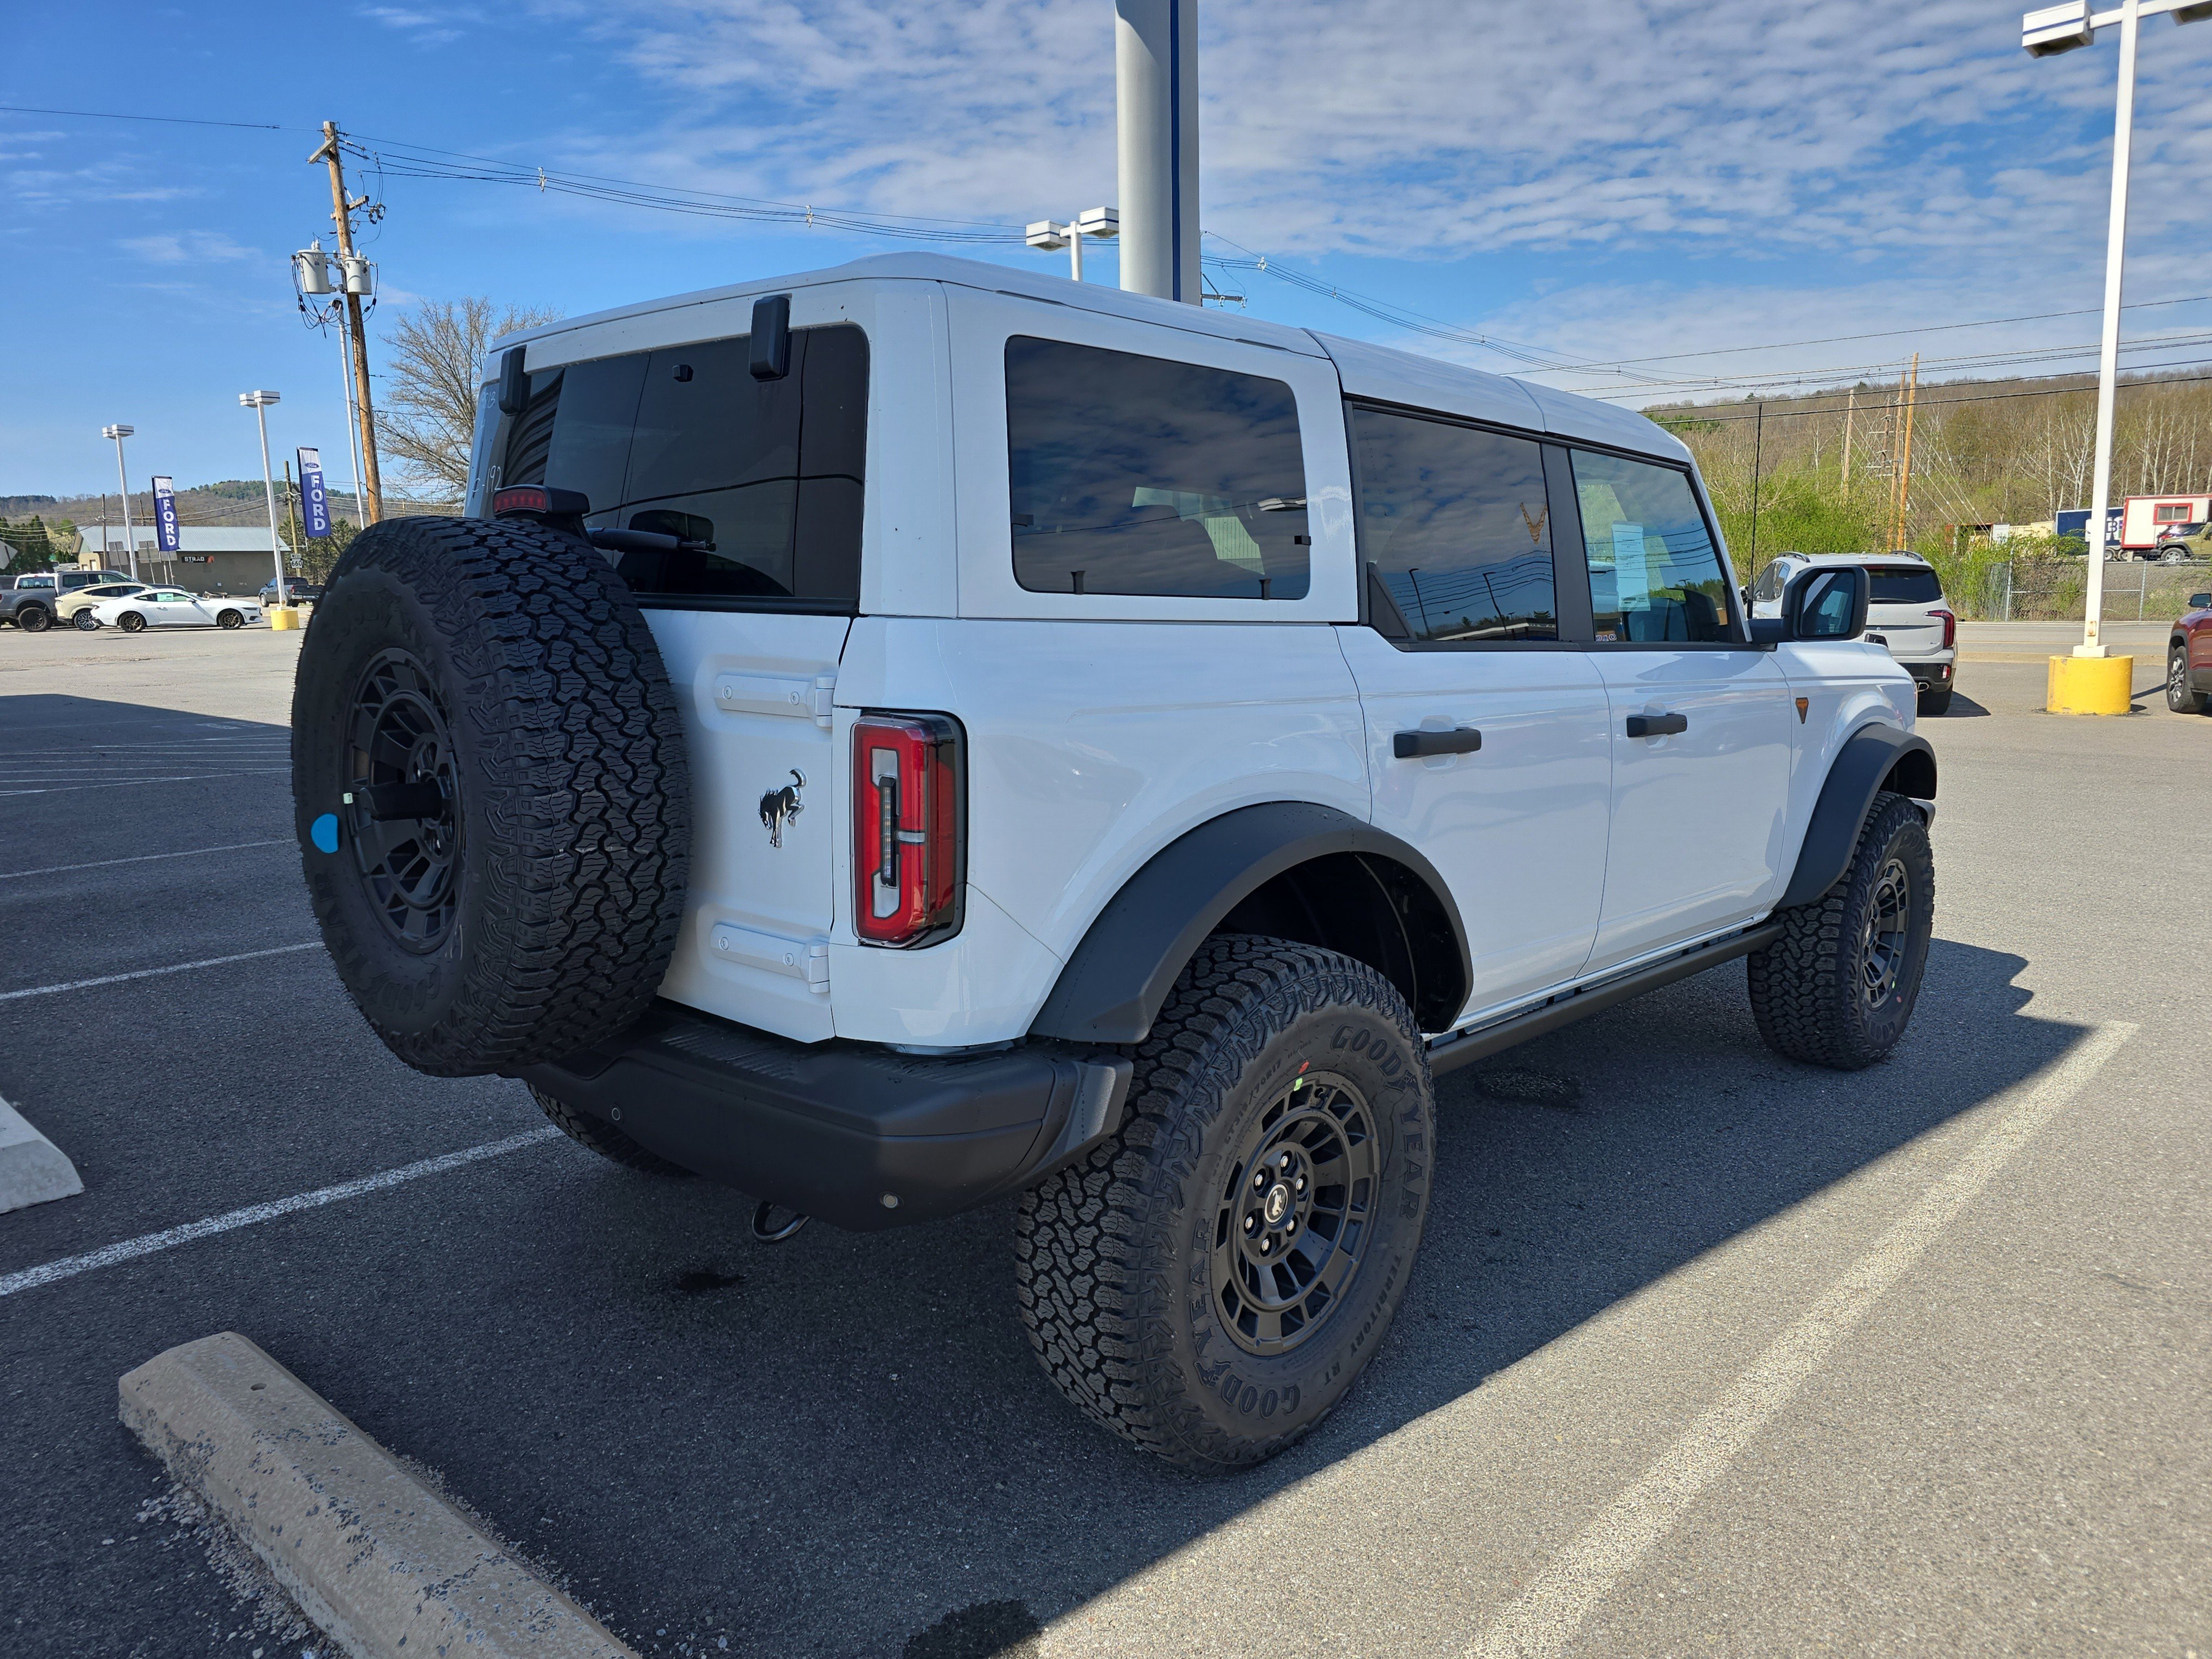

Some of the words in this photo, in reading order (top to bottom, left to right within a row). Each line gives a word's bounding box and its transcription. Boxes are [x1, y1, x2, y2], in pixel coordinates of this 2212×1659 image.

[163, 499, 176, 546] FORD
[310, 475, 325, 531] FORD
[1330, 1024, 1424, 1220] GOODYEAR
[1189, 1218, 1301, 1419] GOODYEAR
[1350, 1254, 1403, 1358] TERRITORY
[1324, 1361, 1341, 1386] RT
